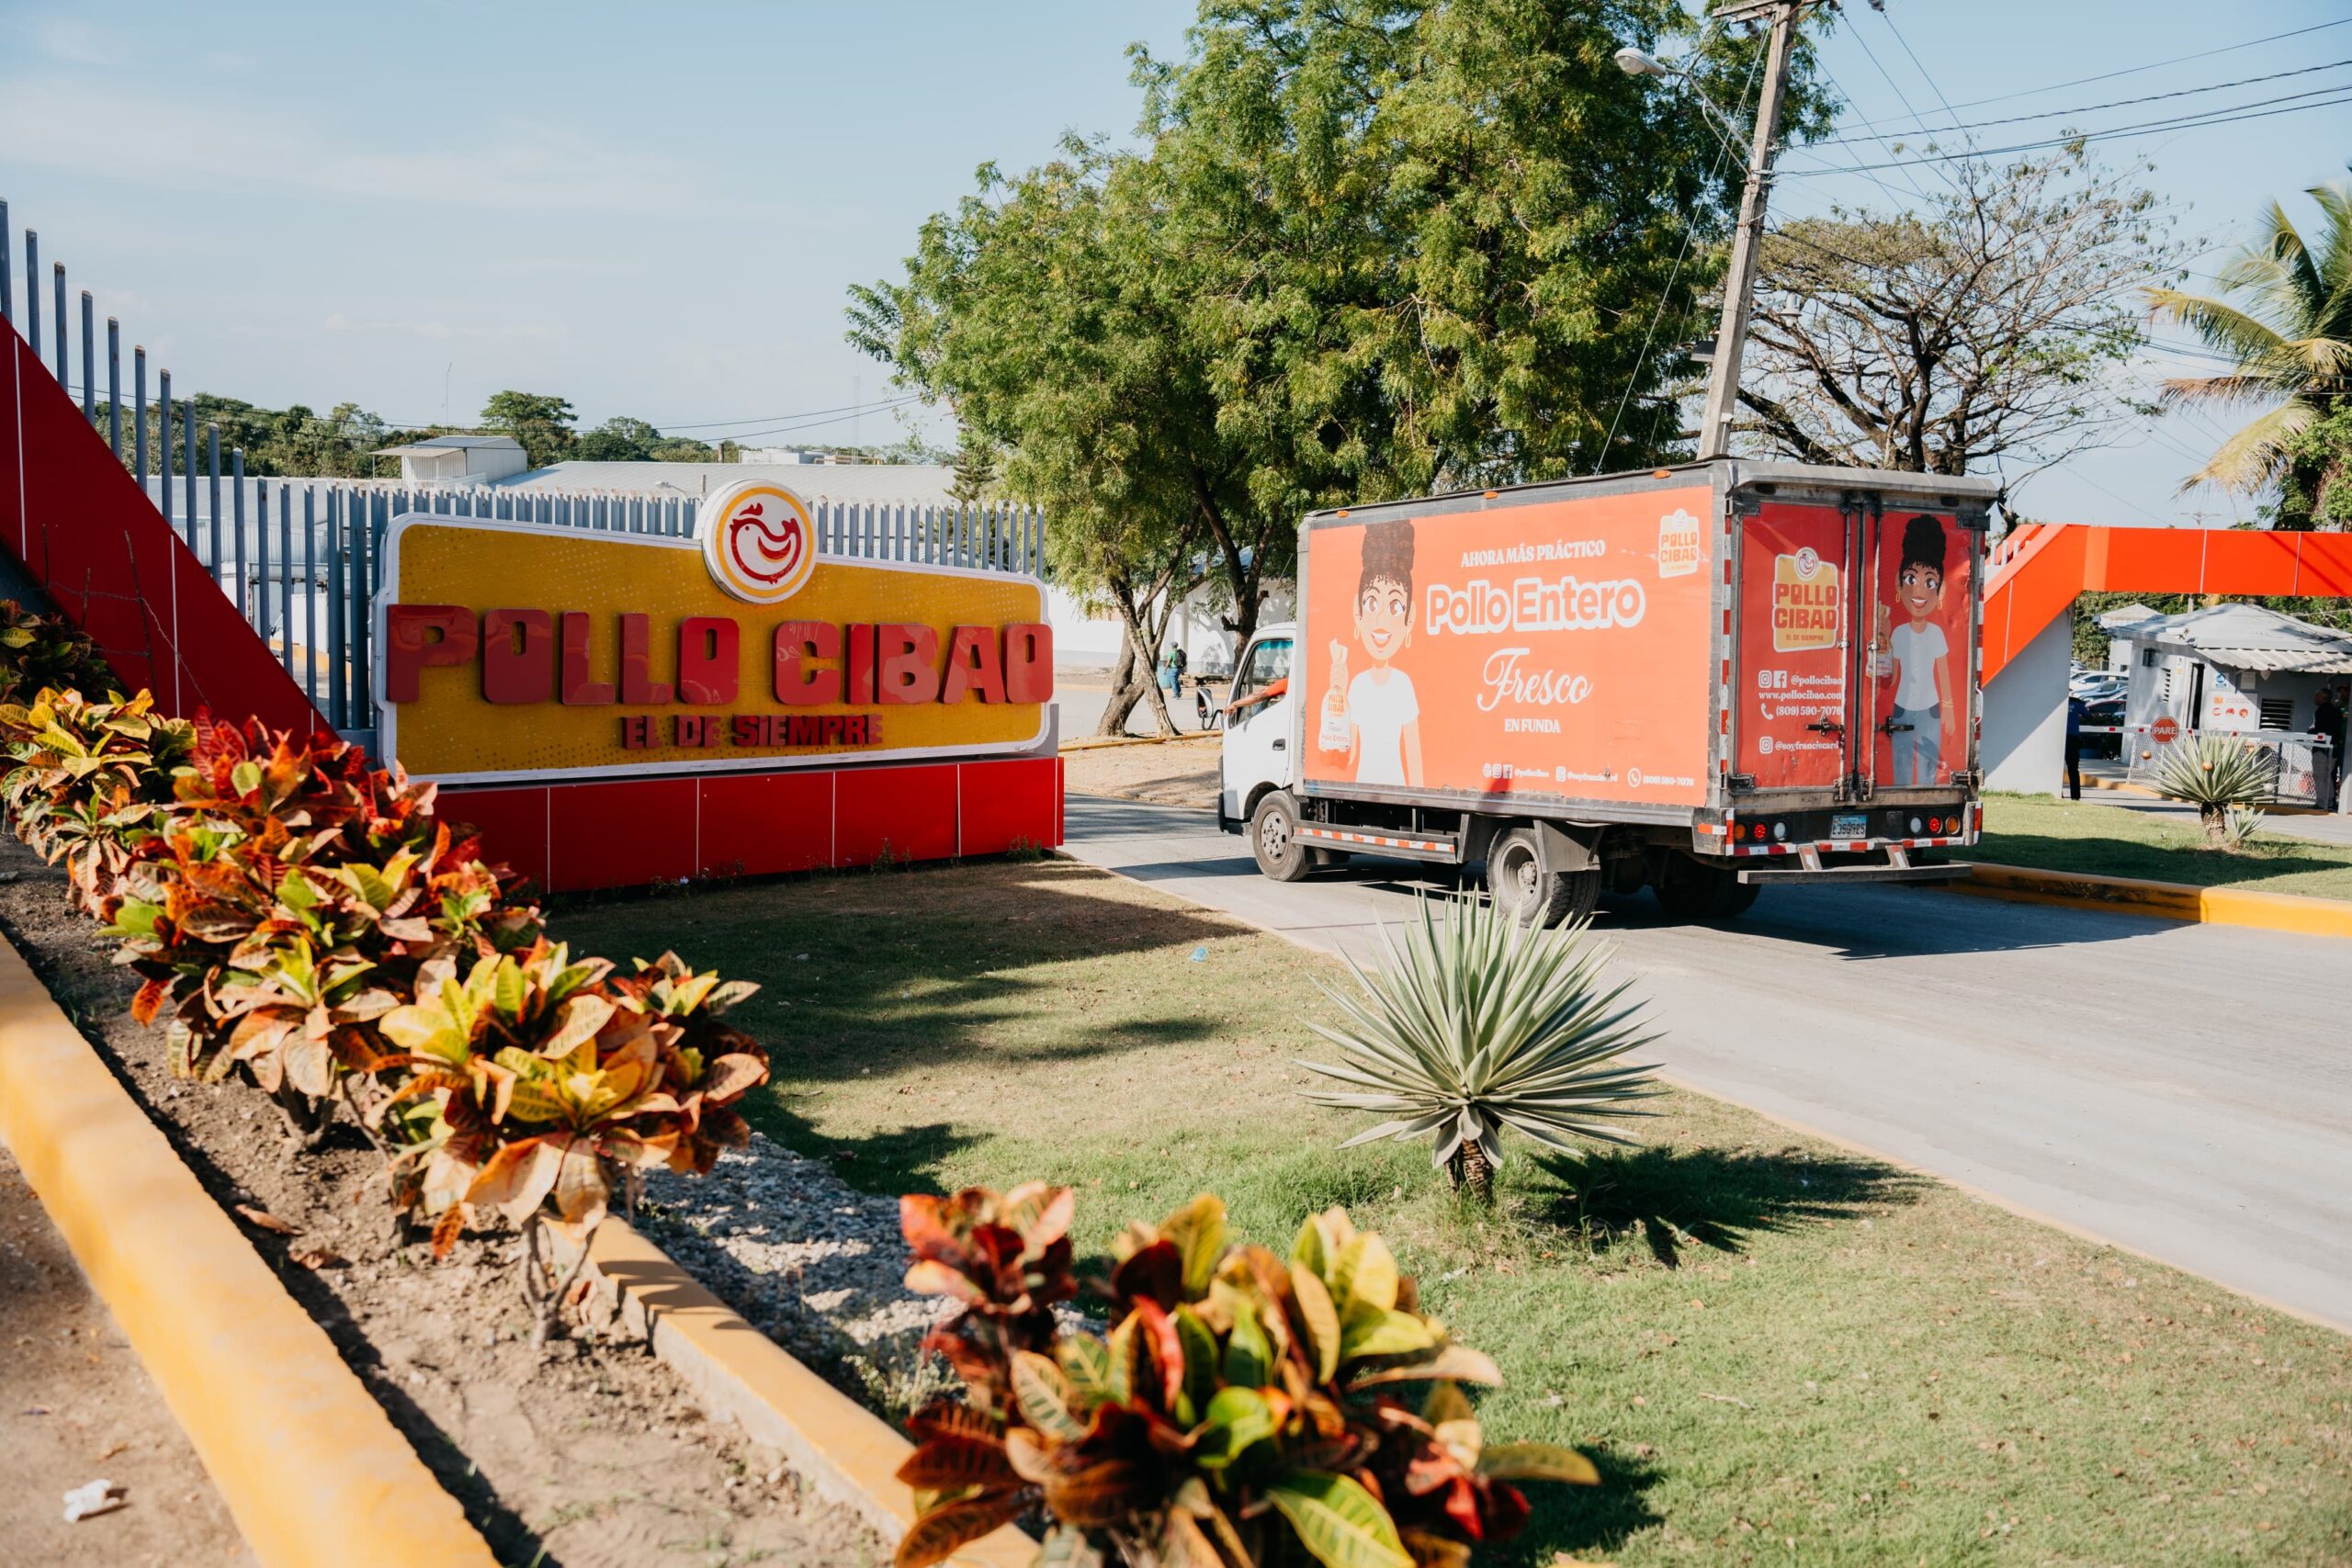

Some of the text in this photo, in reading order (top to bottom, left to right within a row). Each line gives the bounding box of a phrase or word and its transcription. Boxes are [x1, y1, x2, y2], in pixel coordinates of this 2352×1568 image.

[1661, 532, 1697, 547] POLLO
[1461, 538, 1606, 568] AHORA MÁS PRÁCTICO
[1428, 578, 1645, 633] Pollo Entero
[1775, 583, 1838, 606] POLLO
[1775, 608, 1837, 630] CIBAO
[386, 604, 1054, 705] POLLO CIBAO
[1476, 648, 1594, 712] Fresco
[1791, 675, 1843, 687] @pollocibao
[1776, 705, 1799, 716] (809)
[621, 713, 883, 750] EL DE SIEMPRE
[1504, 718, 1562, 734] EN FUNDA
[2154, 727, 2177, 736] PARE
